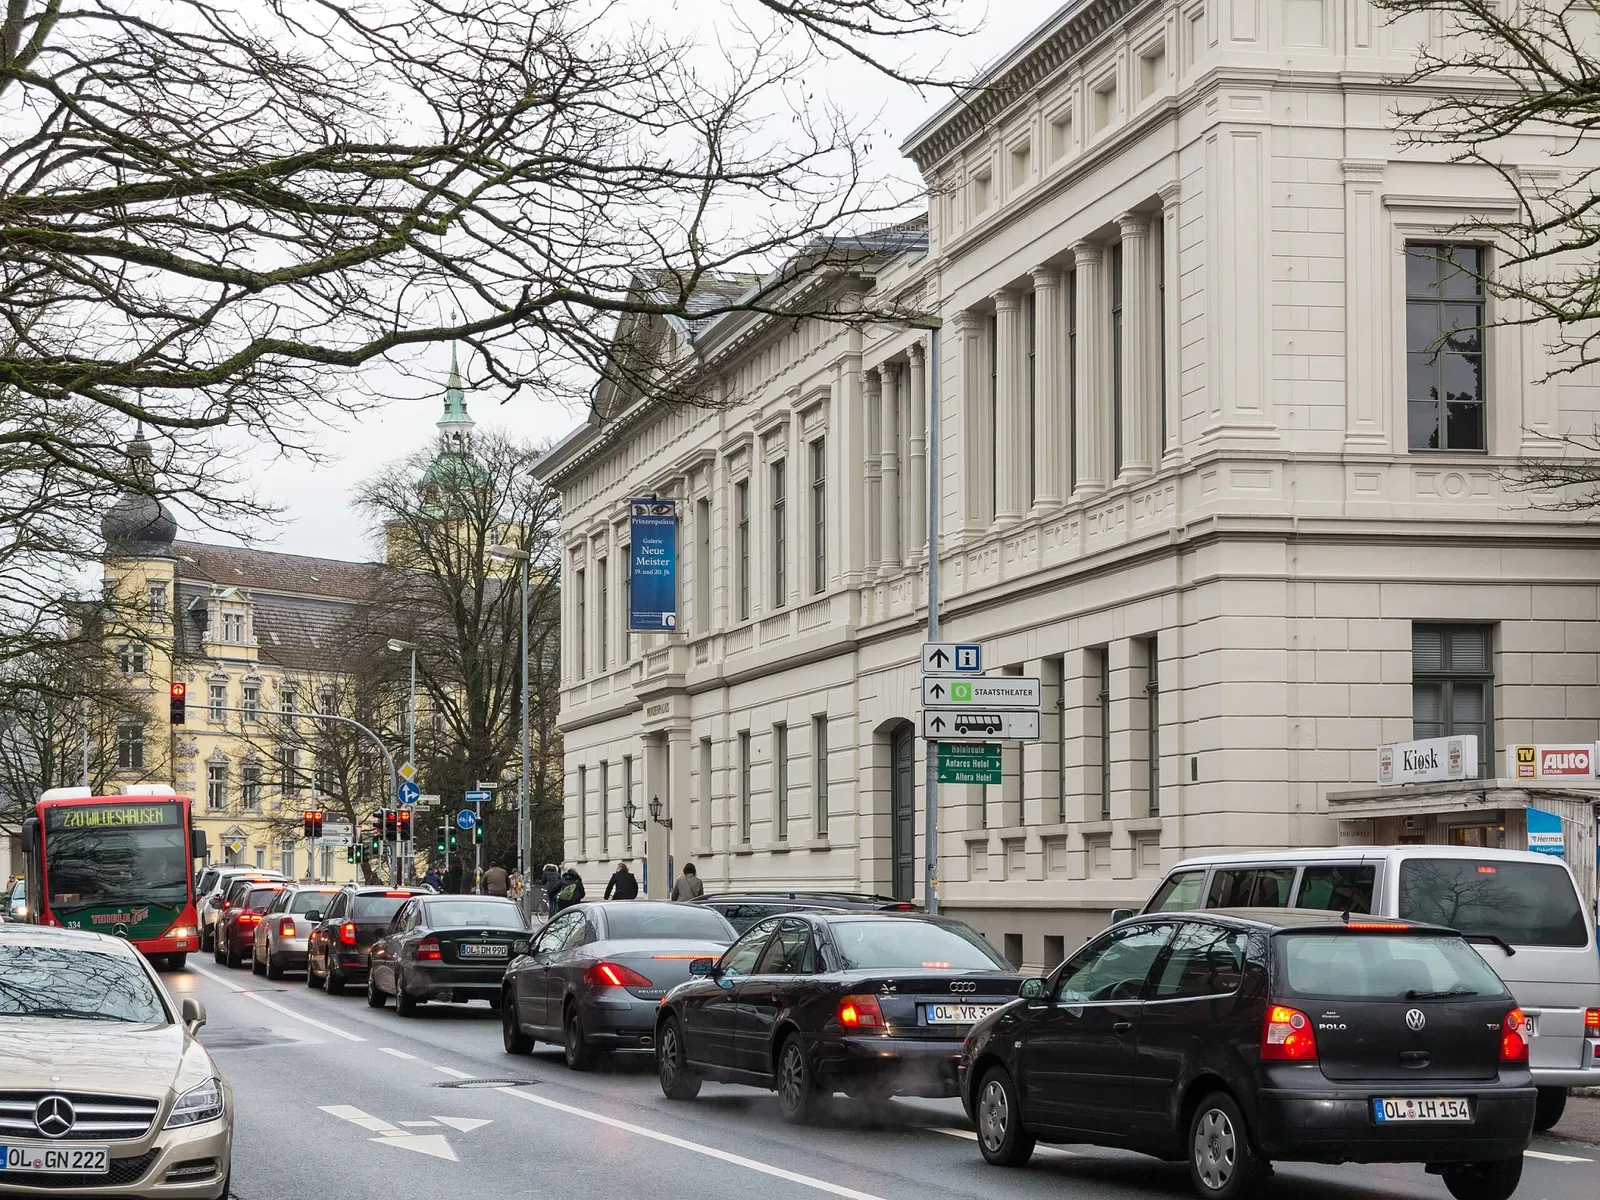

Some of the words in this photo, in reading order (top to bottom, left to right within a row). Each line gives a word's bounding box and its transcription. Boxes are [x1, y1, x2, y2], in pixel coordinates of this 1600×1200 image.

[642, 546, 665, 555] Neue
[636, 557, 670, 566] Meister
[974, 688, 1033, 697] STAATSTHEATER
[951, 746, 985, 754] Hotelroute
[1403, 748, 1438, 771] Kiosk
[1519, 749, 1533, 761] TV
[946, 759, 970, 768] Antares
[972, 759, 989, 768] Hotel
[1543, 753, 1588, 769] Auto
[955, 773, 974, 782] Altera
[976, 773, 992, 782] Hotel
[63, 811, 83, 827] 270
[86, 808, 162, 826] WILDESHAUSEN
[91, 913, 130, 924] THIELE
[68, 921, 81, 929] 334
[466, 946, 476, 954] OL
[935, 1007, 952, 1019] OL
[960, 1006, 977, 1019] YR
[1487, 1023, 1500, 1031] TDI
[1385, 1102, 1406, 1118] OL
[1418, 1101, 1437, 1117] IH
[1440, 1102, 1467, 1117] 154
[9, 1149, 31, 1167] OL
[45, 1151, 69, 1168] GN
[73, 1151, 105, 1168] 222
